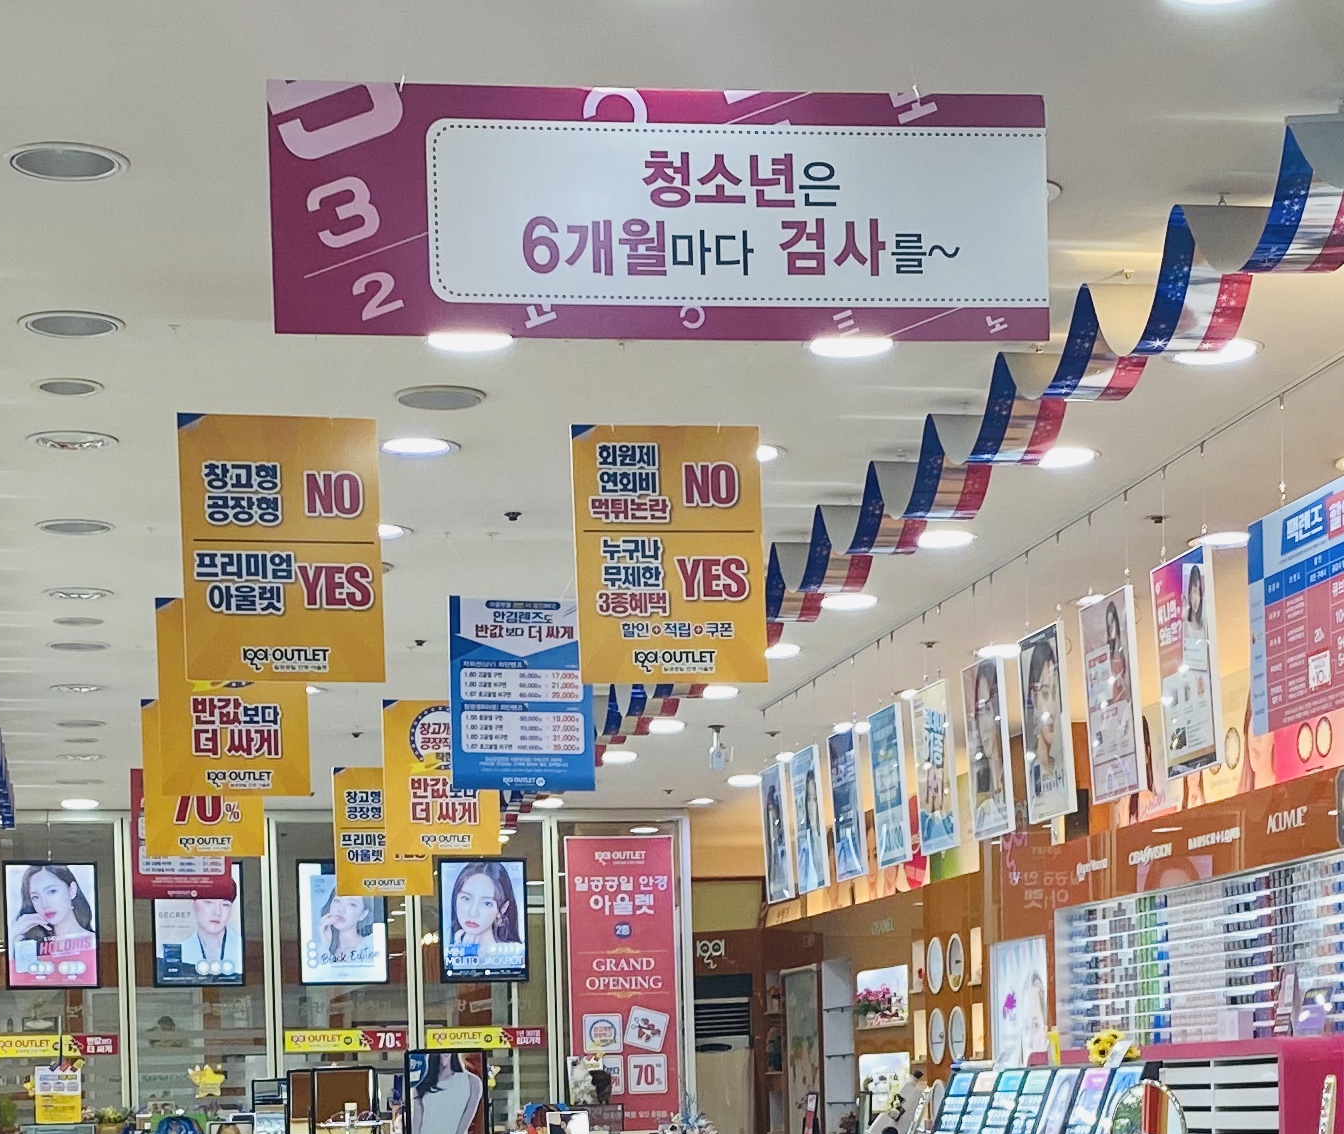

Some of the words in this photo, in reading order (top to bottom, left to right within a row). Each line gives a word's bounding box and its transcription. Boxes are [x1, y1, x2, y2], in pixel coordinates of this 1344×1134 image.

[642, 151, 841, 208] 청소년은
[522, 215, 754, 277] 6개월마다
[598, 443, 656, 467] 회원제
[203, 463, 280, 491] 창고형
[599, 470, 657, 495] 연회비
[684, 463, 737, 505] NO
[305, 472, 362, 517] NO
[206, 496, 282, 524] 공장형
[591, 498, 668, 520] 먹튀논란
[1286, 504, 1323, 542] 팩렌즈
[602, 538, 661, 561] 누구나
[195, 552, 294, 581] 프리미엄
[603, 565, 662, 588] 무제한
[299, 565, 373, 609] YES
[677, 557, 747, 600] YES
[208, 584, 283, 614] 아울렛
[598, 592, 667, 614] 3종혜택
[528, 625, 542, 642] 더
[546, 625, 574, 639] 싸게
[272, 648, 330, 662] OUTLET
[662, 650, 715, 663] OUTLET
[192, 697, 280, 725] 반값보다
[194, 728, 220, 756] 더
[227, 728, 279, 756] 싸게
[229, 772, 272, 781] OUTLET
[346, 790, 382, 804] 창고형
[347, 806, 382, 820] 공장형
[412, 802, 430, 823] 더
[437, 802, 478, 823] 싸게
[197, 837, 231, 846] OUTLET
[439, 834, 471, 843] OUTLET
[348, 849, 383, 863] 아울렛
[612, 851, 646, 860] OUTLET
[574, 876, 633, 892] 일공공일
[639, 875, 668, 891] 안경
[158, 911, 191, 919] SECRET
[589, 894, 654, 915] 아울렛
[592, 957, 655, 971] GRAND
[586, 976, 663, 990] OPENING
[16, 1039, 50, 1048] OUTLET
[308, 1034, 342, 1043] OUTLET
[449, 1032, 481, 1041] OUTLET
